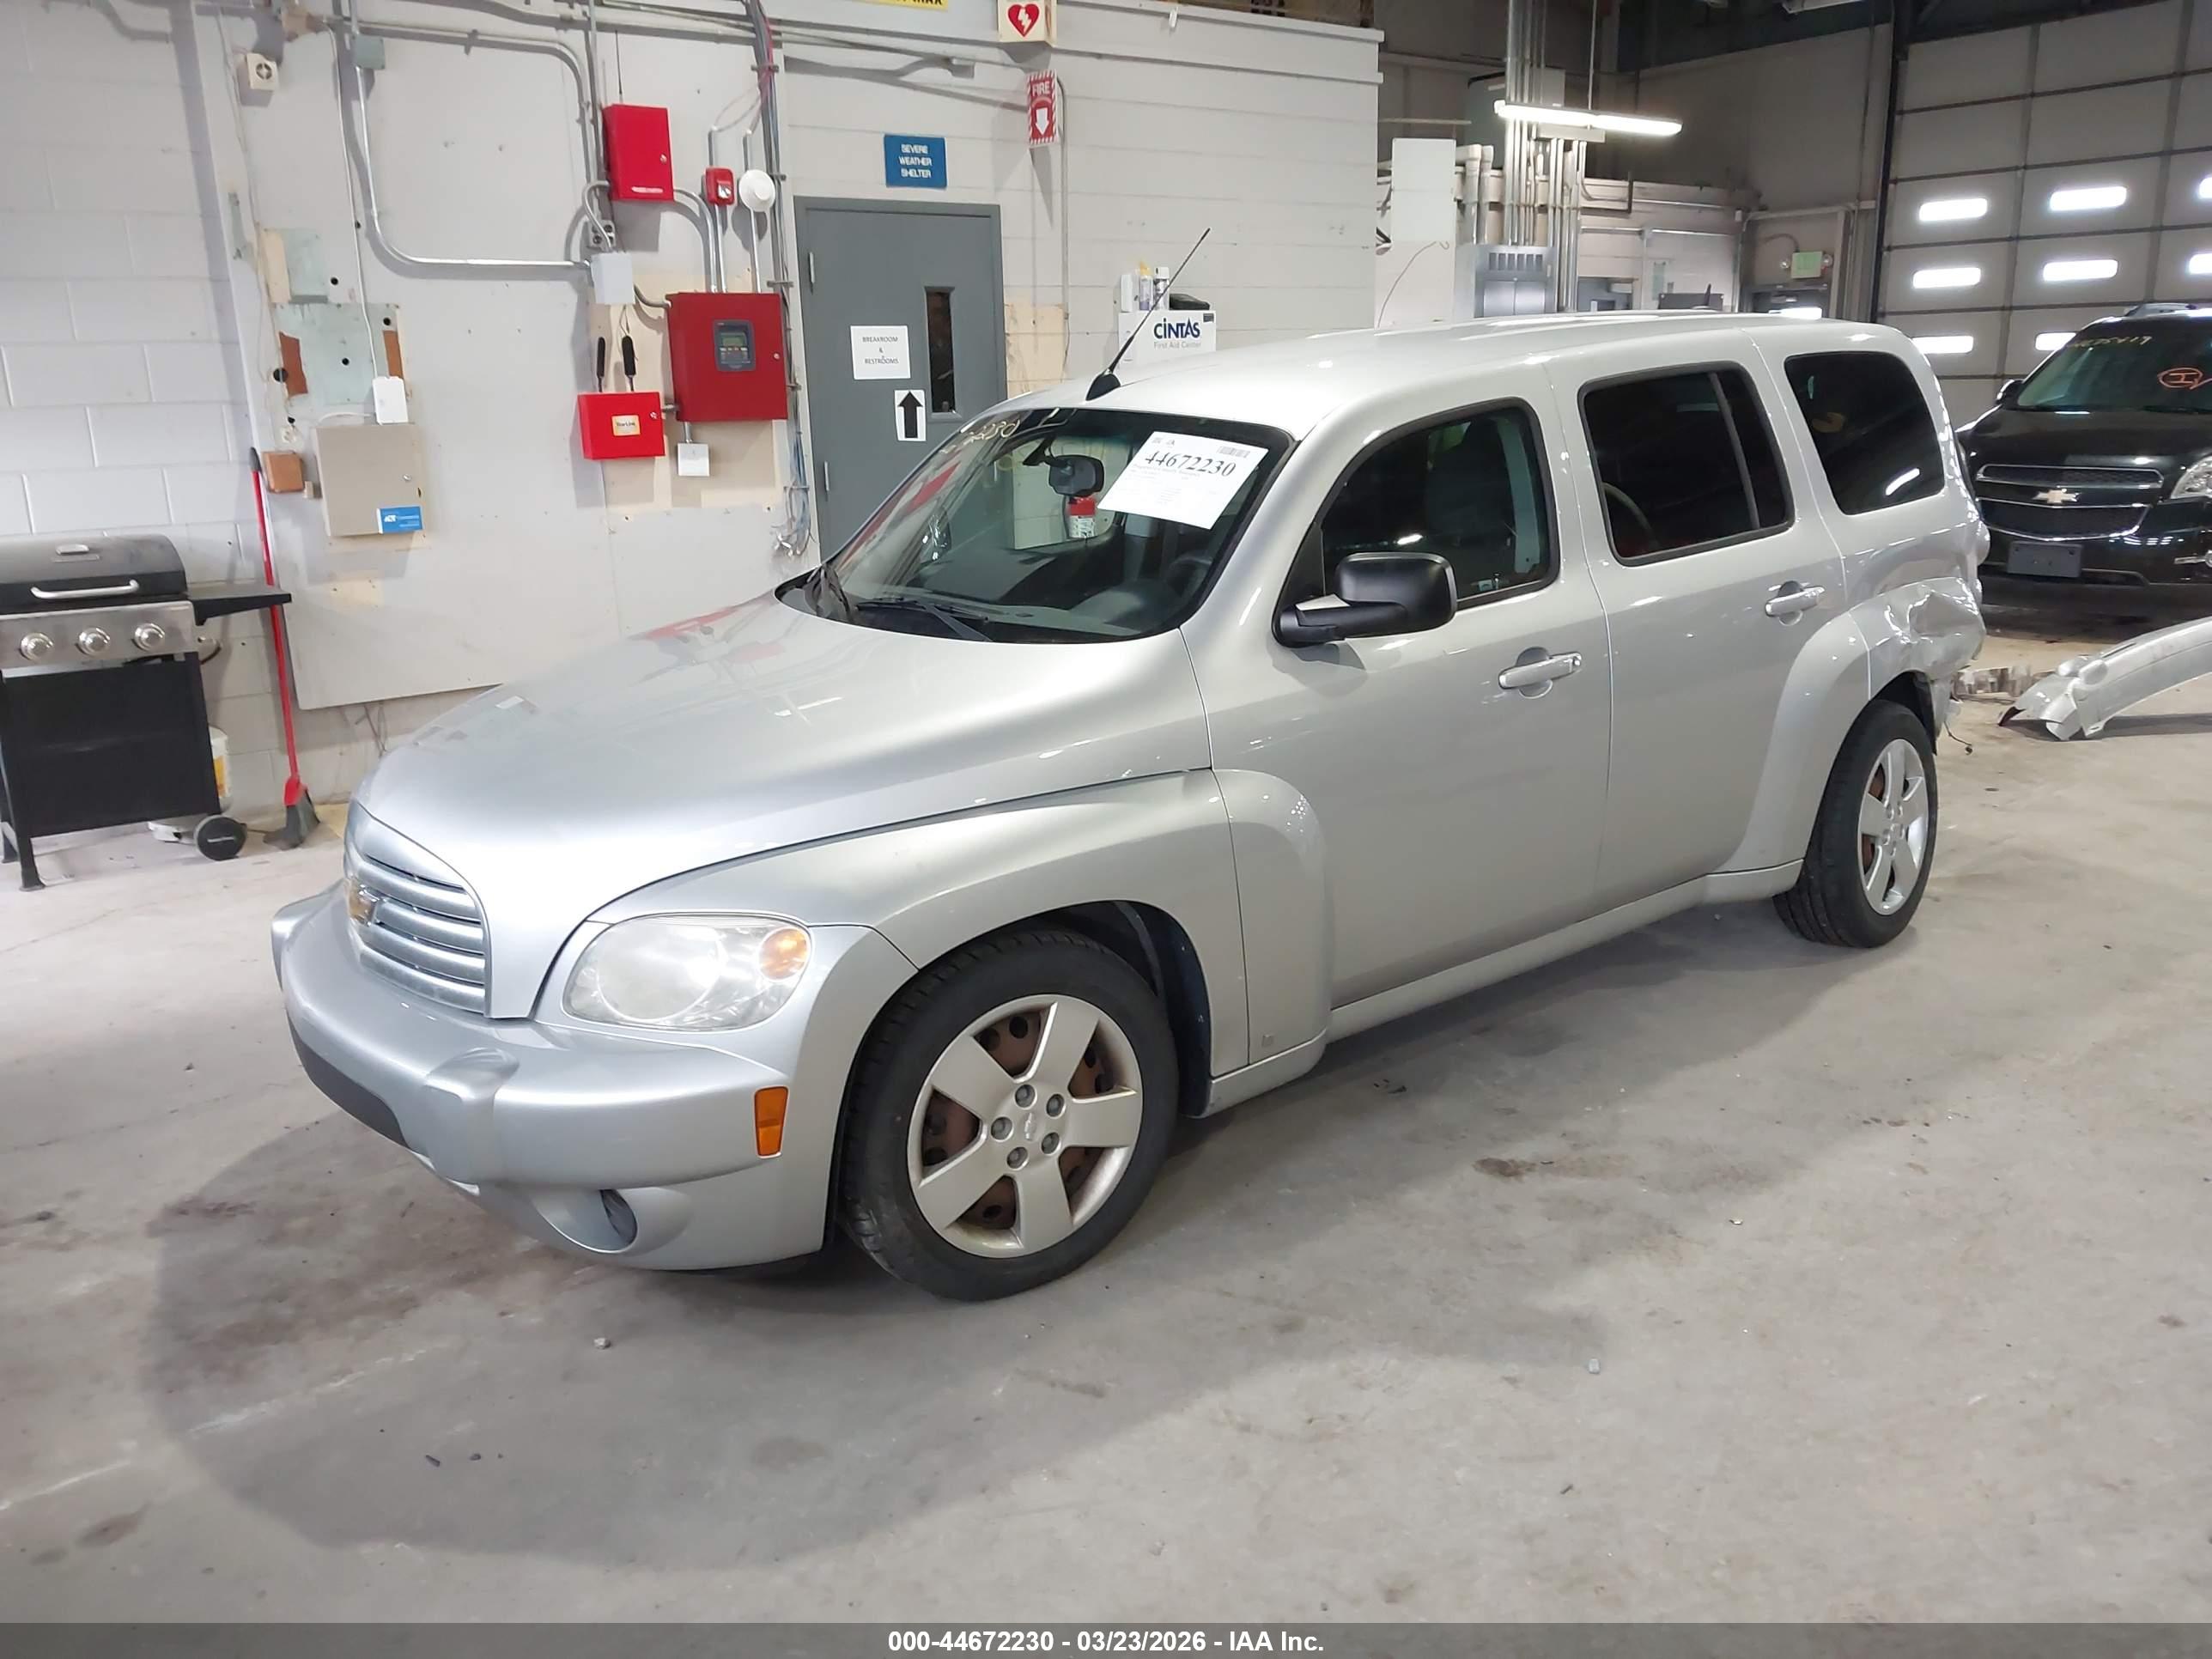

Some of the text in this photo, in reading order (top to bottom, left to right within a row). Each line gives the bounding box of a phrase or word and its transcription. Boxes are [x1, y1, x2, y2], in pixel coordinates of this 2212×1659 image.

[1032, 81, 1050, 97] FIRE
[901, 143, 928, 155] SEVERE
[898, 155, 933, 167] WEATHER
[901, 168, 932, 179] SHELTER
[1145, 450, 1237, 477] 44672230
